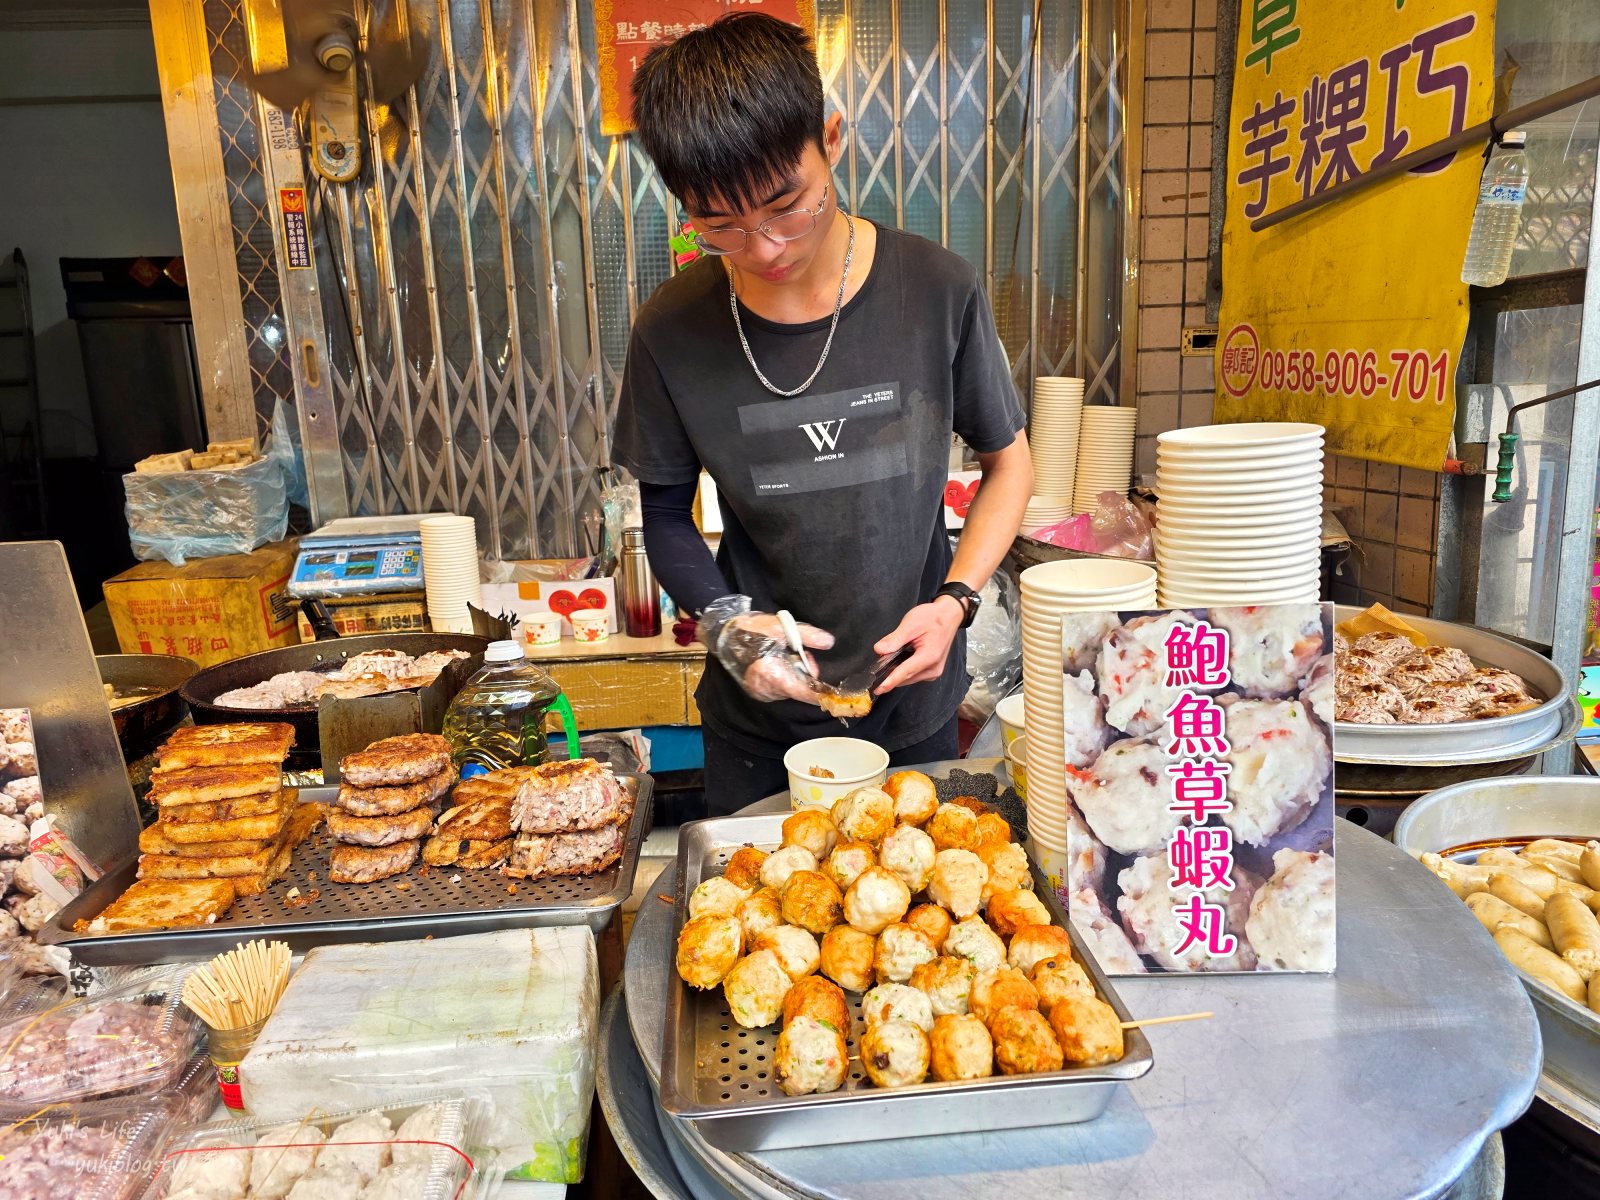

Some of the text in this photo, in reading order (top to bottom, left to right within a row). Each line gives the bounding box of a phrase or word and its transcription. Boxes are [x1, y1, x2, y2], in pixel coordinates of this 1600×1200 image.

[1237, 15, 1476, 218] 芋粿巧
[286, 213, 299, 266] 警報系統連線中
[294, 214, 308, 266] 24小時錄影監控
[1223, 347, 1256, 375] 郭記
[1260, 350, 1448, 401] 0958-906-701
[814, 453, 837, 462] ASHION
[1164, 624, 1235, 956] 鮑魚草蝦丸
